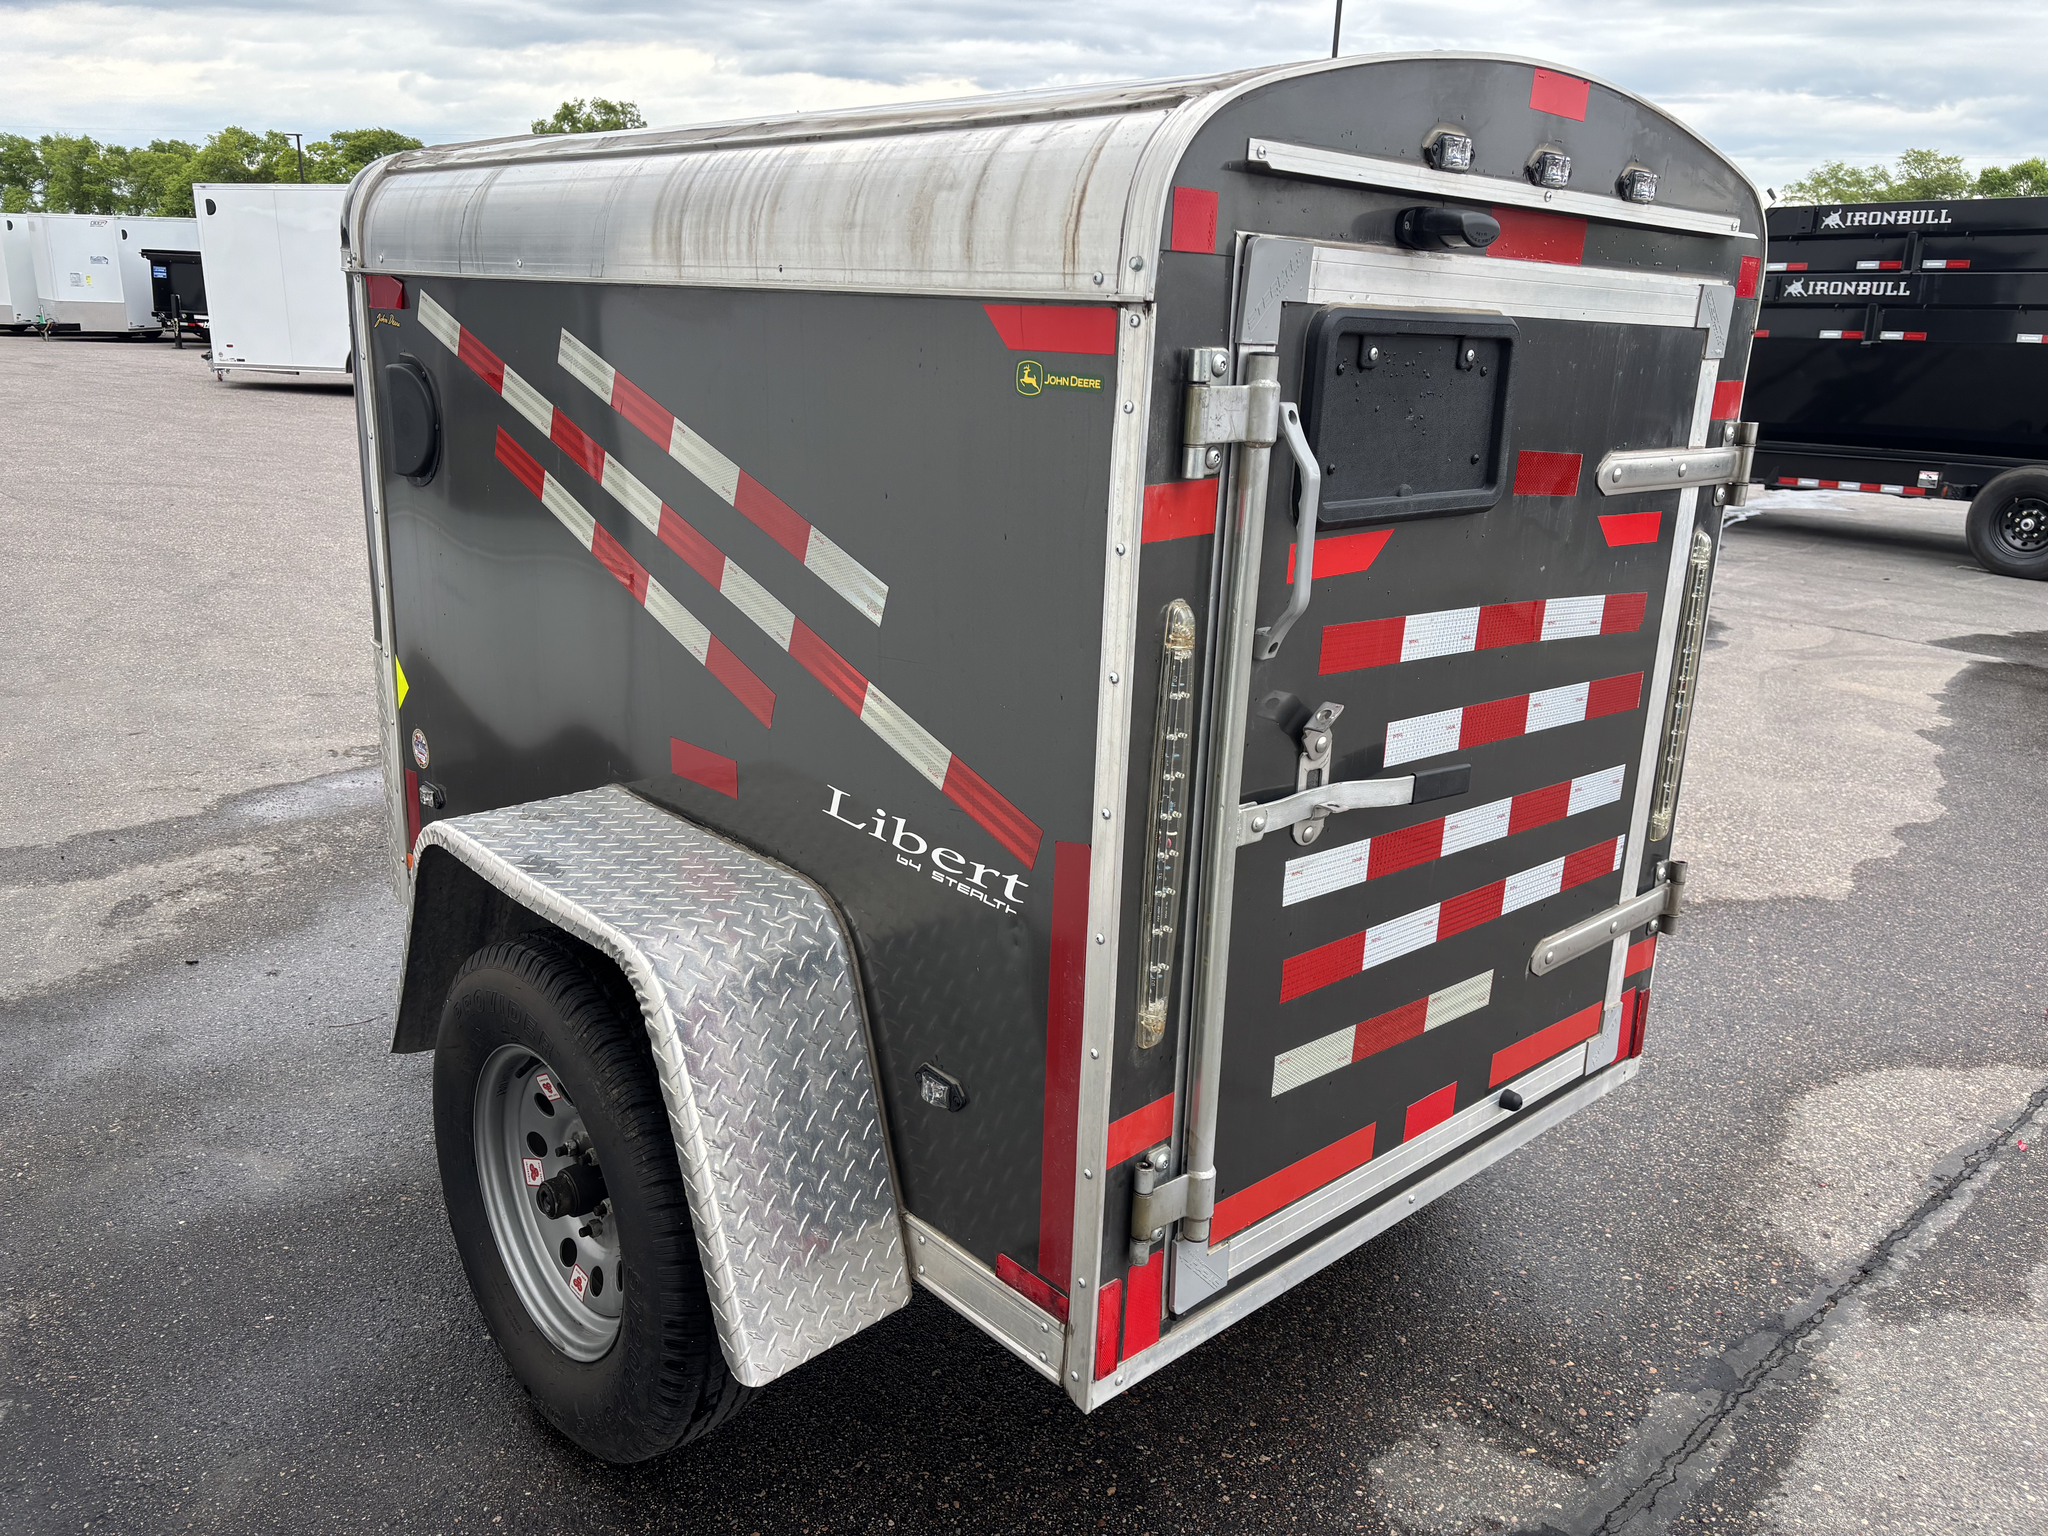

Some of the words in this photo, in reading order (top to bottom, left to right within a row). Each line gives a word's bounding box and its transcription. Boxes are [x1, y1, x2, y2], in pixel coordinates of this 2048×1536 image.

[1845, 209, 1952, 226] IRONBULL
[1807, 281, 1911, 296] IRONBULL
[1044, 373, 1070, 387] JOHN
[1070, 376, 1102, 389] DEERE
[822, 784, 1029, 904] Libert
